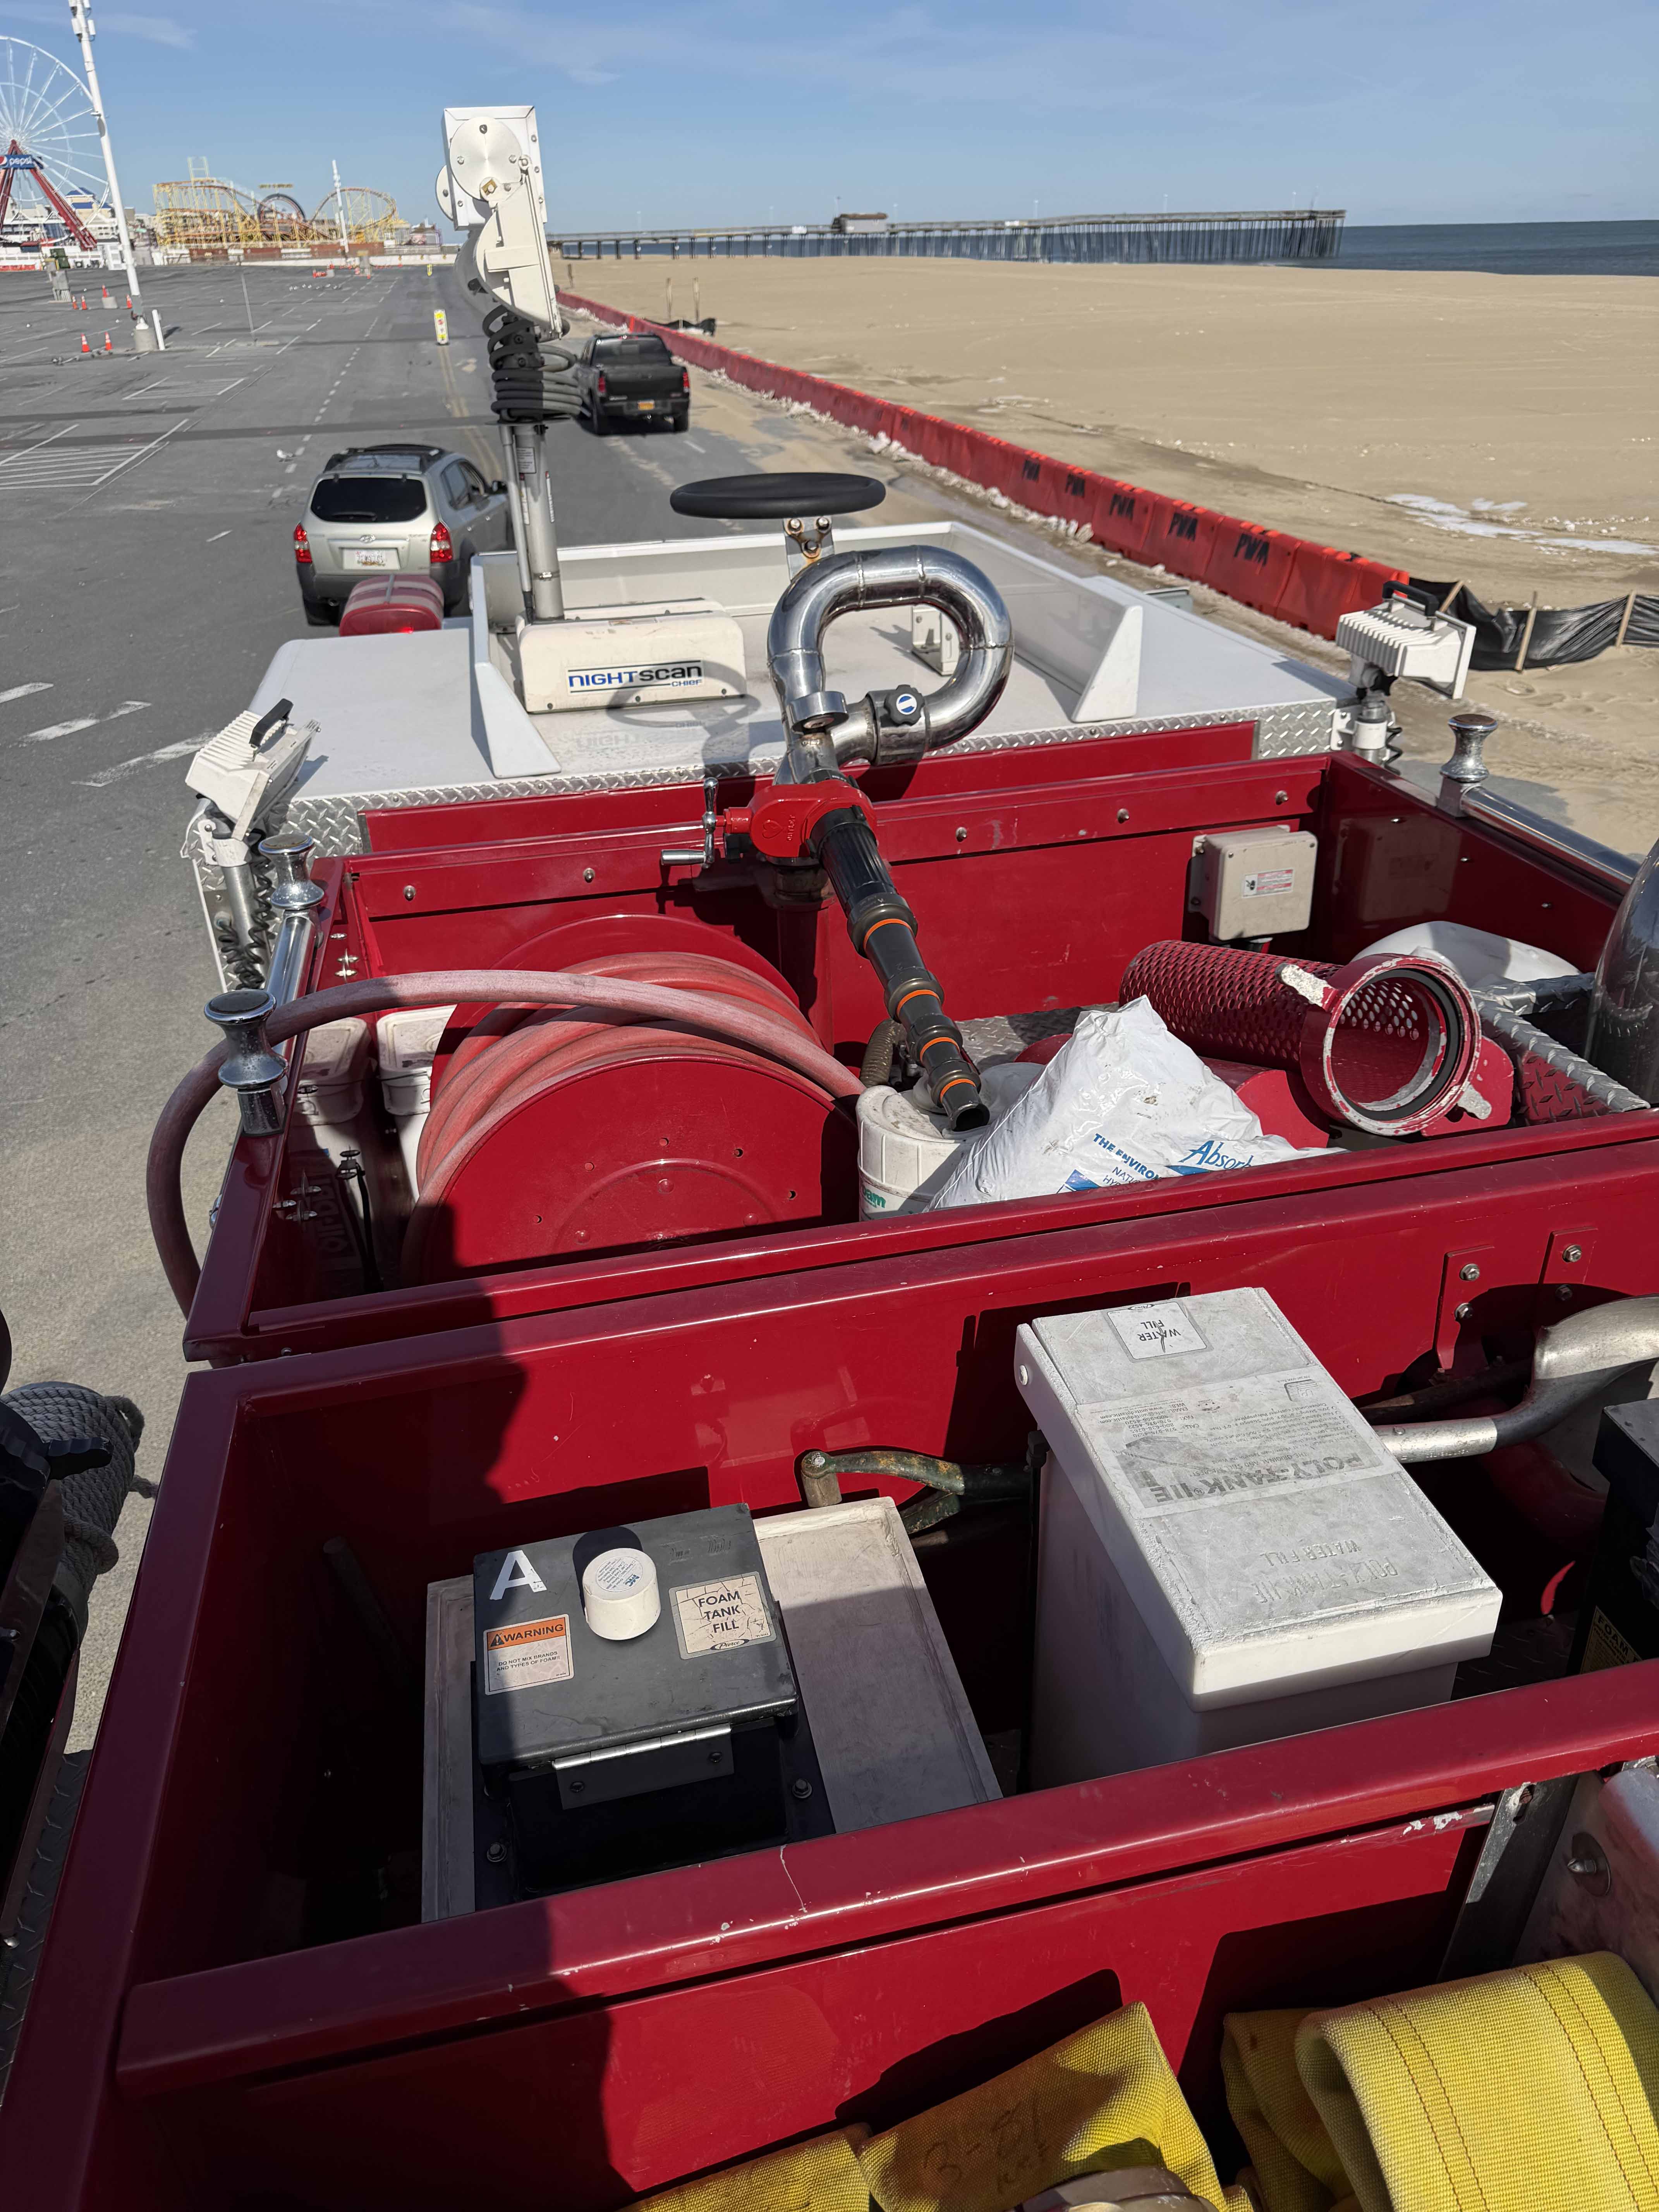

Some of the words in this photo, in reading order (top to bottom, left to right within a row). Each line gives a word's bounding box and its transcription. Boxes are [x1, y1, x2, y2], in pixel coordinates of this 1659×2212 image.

[1093, 1133, 1116, 1152] THE
[1140, 1319, 1165, 1329] FILL
[1136, 1328, 1181, 1341] WATER
[1300, 1537, 1362, 1561] WATER
[1258, 1547, 1302, 1568] FILL
[489, 1550, 547, 1601] A
[698, 1591, 740, 1607] FOAM
[704, 1604, 741, 1620] TANK
[503, 1624, 563, 1642] WARNING
[713, 1621, 739, 1633] FILL
[718, 1640, 740, 1650] Pierce
[534, 1651, 558, 1660] BRANDS
